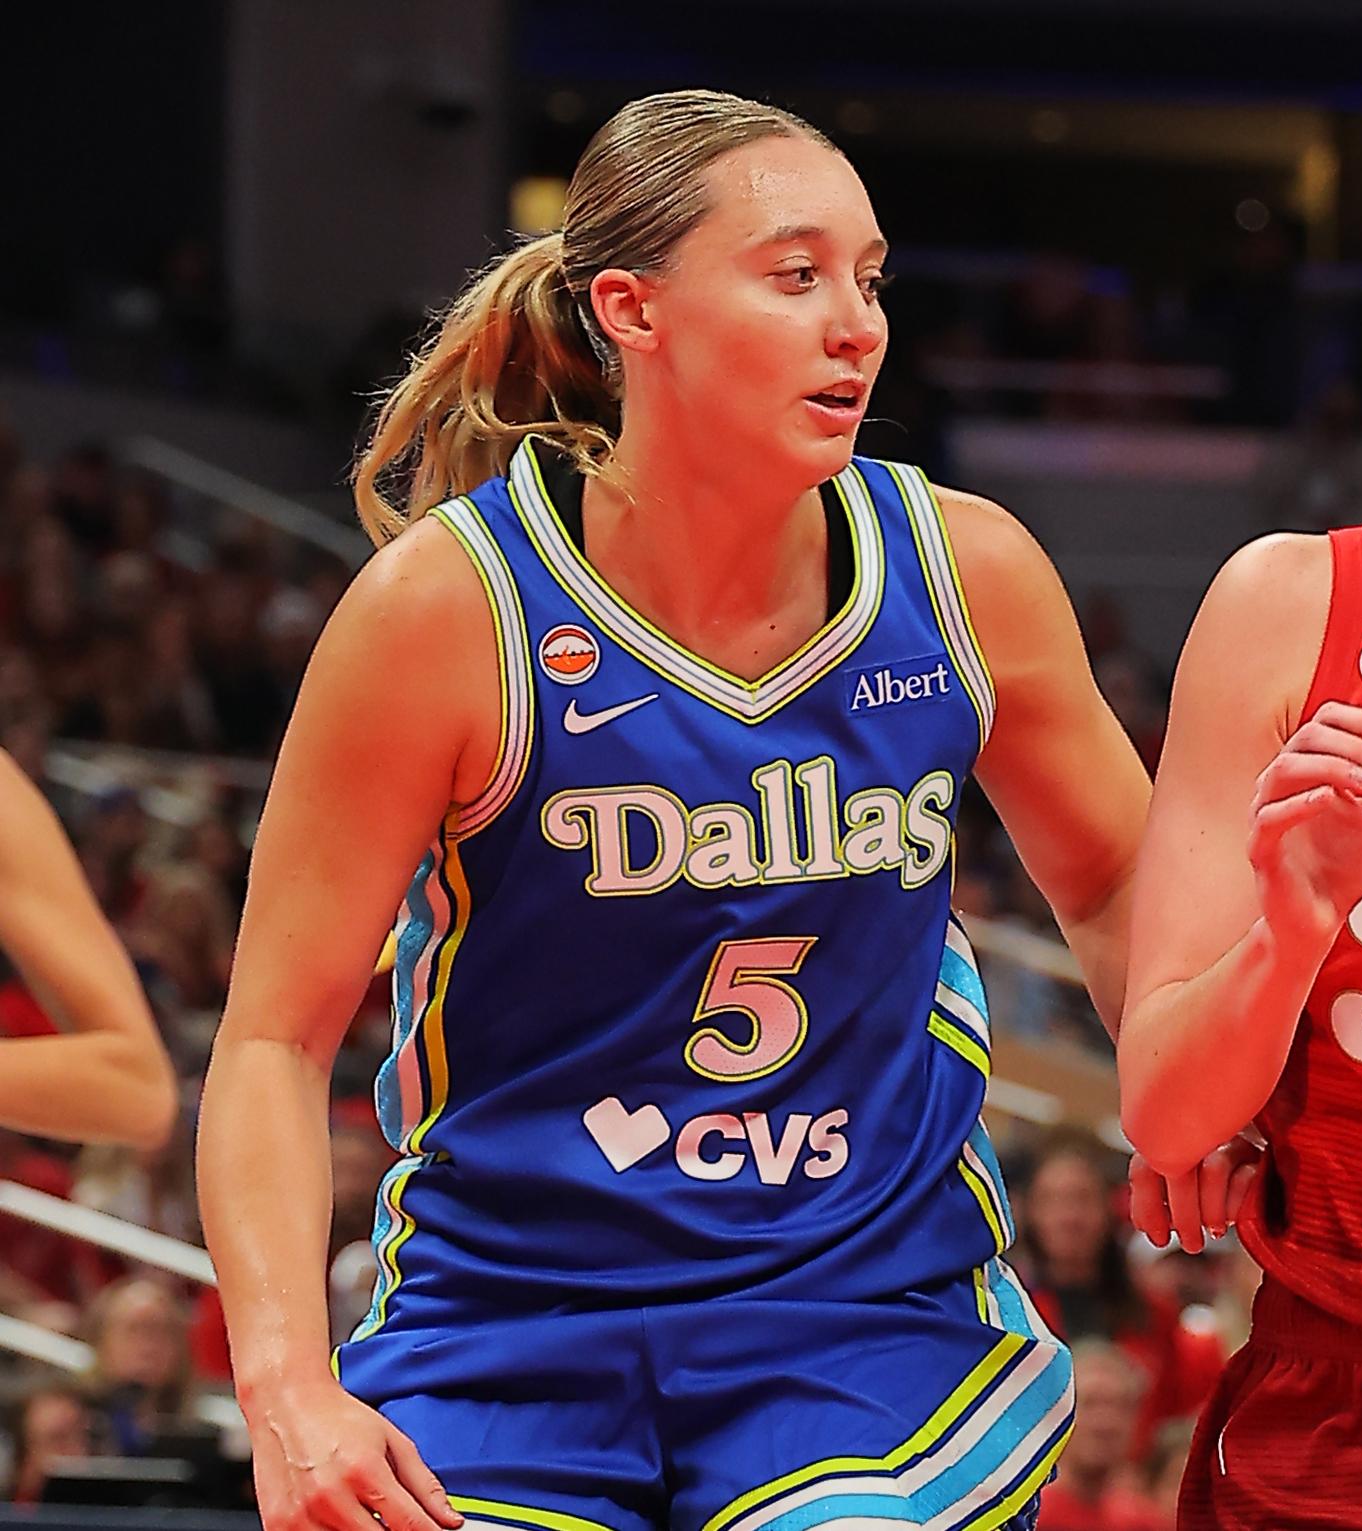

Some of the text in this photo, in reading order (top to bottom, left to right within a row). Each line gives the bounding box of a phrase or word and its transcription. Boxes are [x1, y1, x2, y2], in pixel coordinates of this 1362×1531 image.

[850, 664, 950, 711] Albert
[541, 754, 955, 896] Dallas
[684, 936, 819, 1082] 5
[675, 1108, 849, 1185] CVS
